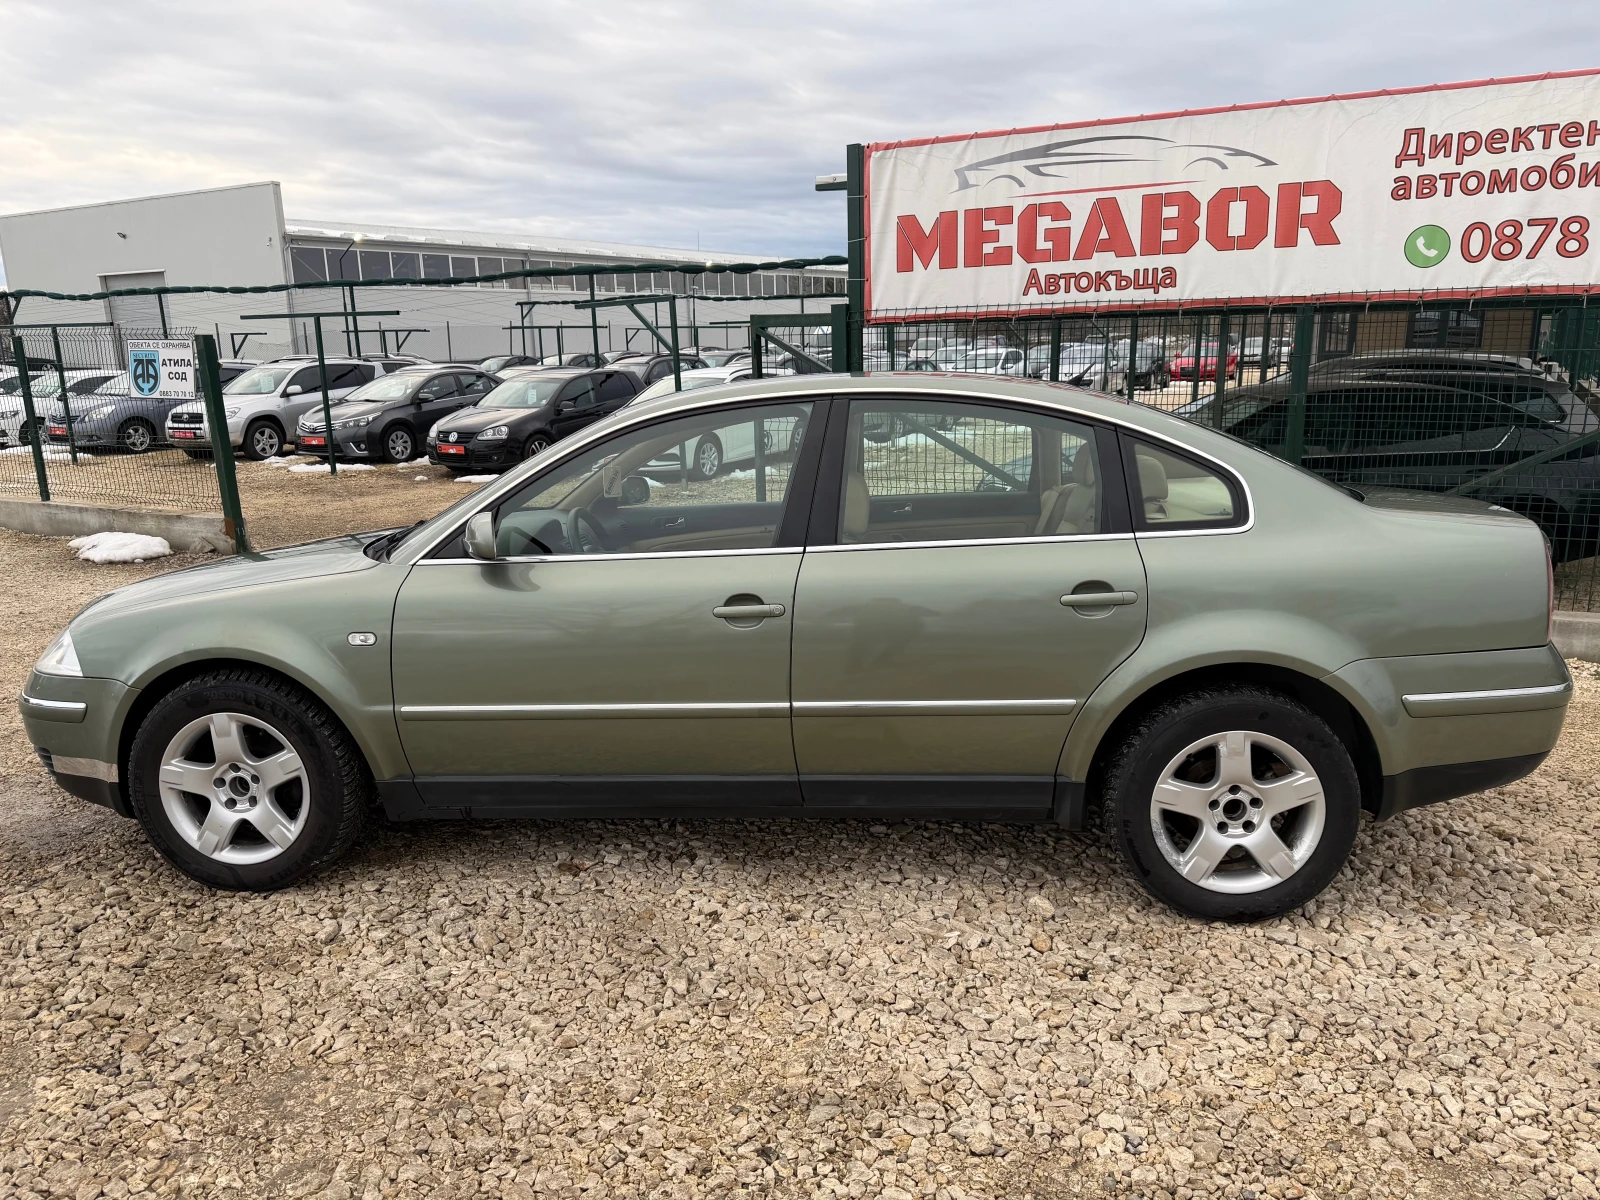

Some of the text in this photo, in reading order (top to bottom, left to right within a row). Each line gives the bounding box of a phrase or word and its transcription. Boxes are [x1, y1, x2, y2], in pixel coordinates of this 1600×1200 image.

[1390, 153, 1600, 201] автомоби
[896, 180, 1343, 273] MEGABOR
[1460, 215, 1590, 263] 0878
[1022, 266, 1177, 296] Автокъща
[161, 358, 192, 367] АТИЛА
[168, 371, 188, 382] СОД
